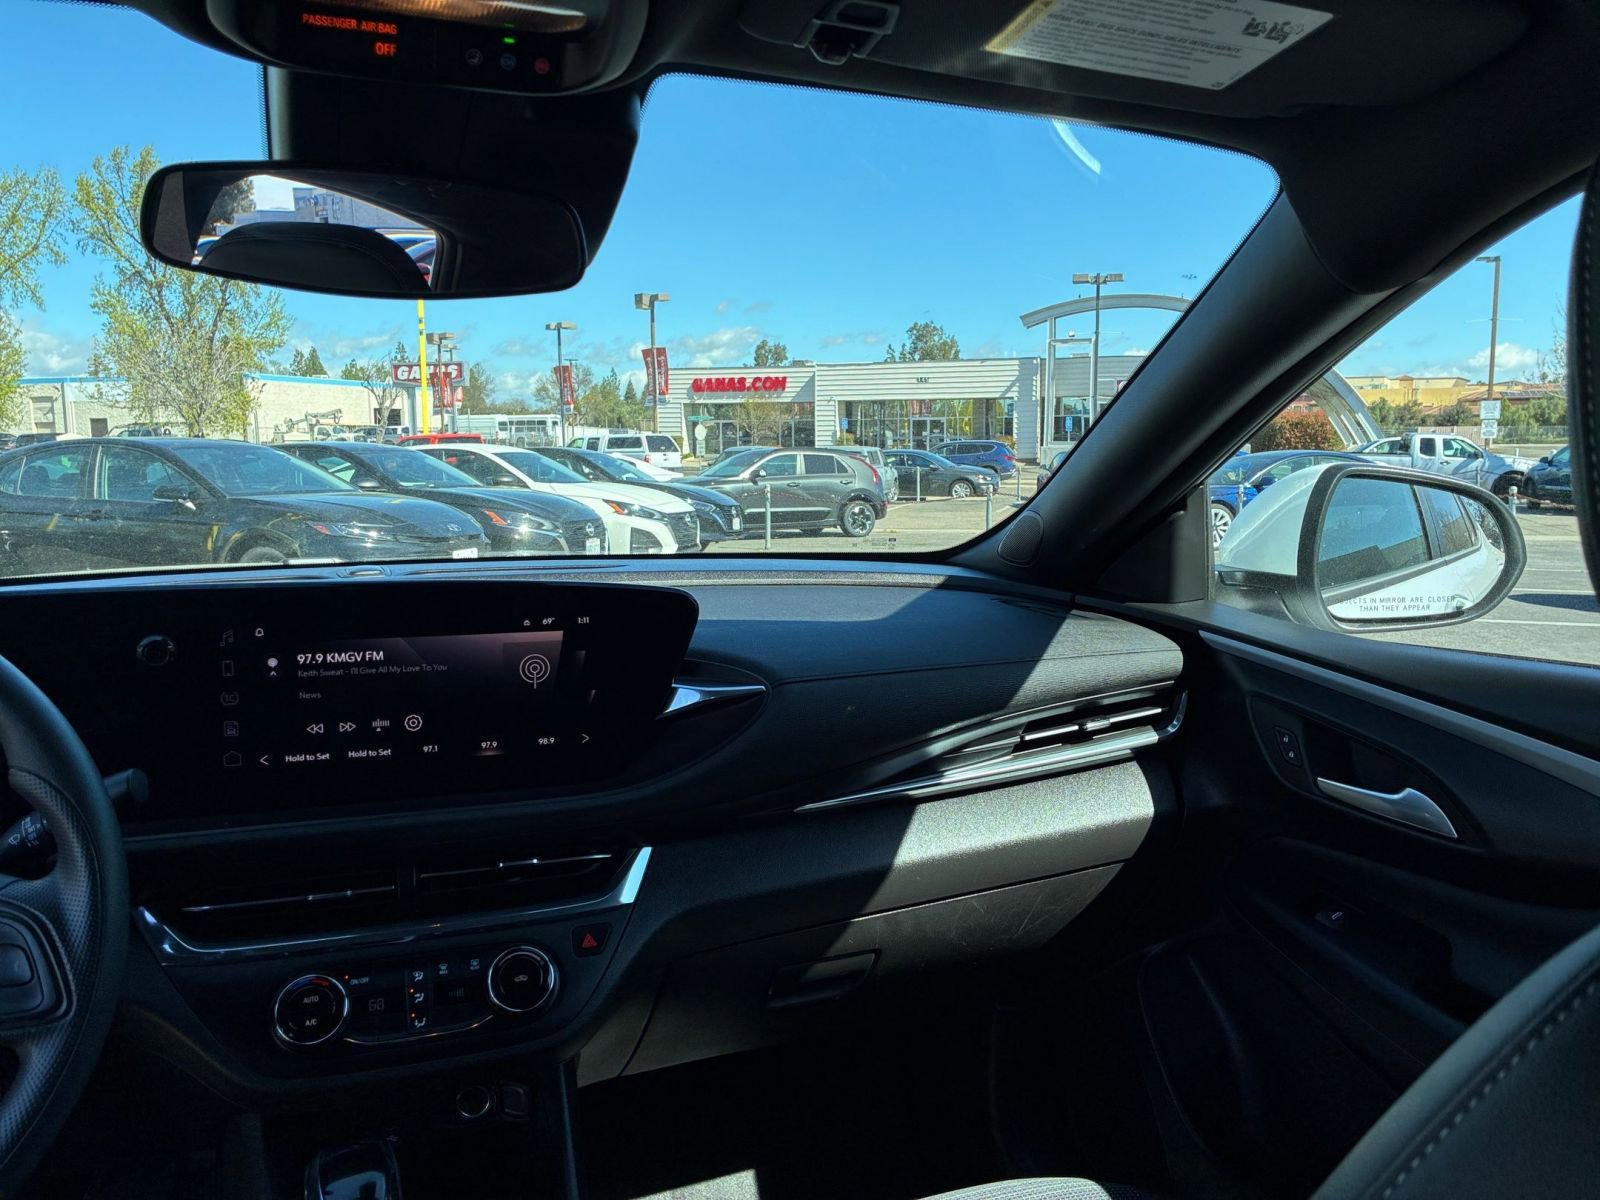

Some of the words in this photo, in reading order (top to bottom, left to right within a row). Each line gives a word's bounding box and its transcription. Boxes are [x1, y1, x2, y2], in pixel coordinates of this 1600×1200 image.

[302, 13, 357, 30] PASSENGER
[375, 42, 397, 56] OFF
[691, 376, 788, 393] GANAS.COM
[1428, 595, 1455, 603] CLOSER
[1381, 604, 1399, 612] THEY
[297, 653, 323, 664] 97.9
[326, 651, 363, 663] KMGV
[365, 650, 384, 662] FM
[298, 669, 319, 678] Keith
[320, 668, 344, 677] Sweat
[359, 666, 377, 674] Give
[377, 665, 388, 673] All
[389, 664, 401, 675] My
[402, 664, 421, 673] Love
[421, 663, 432, 671] To
[433, 663, 448, 671] You
[299, 691, 322, 700] News
[481, 741, 498, 749] 97.9
[538, 737, 555, 745] 98.9
[348, 750, 367, 758] Hold
[368, 749, 377, 757] to
[378, 748, 391, 756] Set
[423, 745, 438, 753] 97.1
[285, 754, 305, 762] Hold
[306, 753, 315, 761] to
[316, 752, 330, 760] Set
[303, 994, 320, 1004] AUTO
[368, 997, 385, 1012] 68
[304, 1017, 318, 1027] A/C
